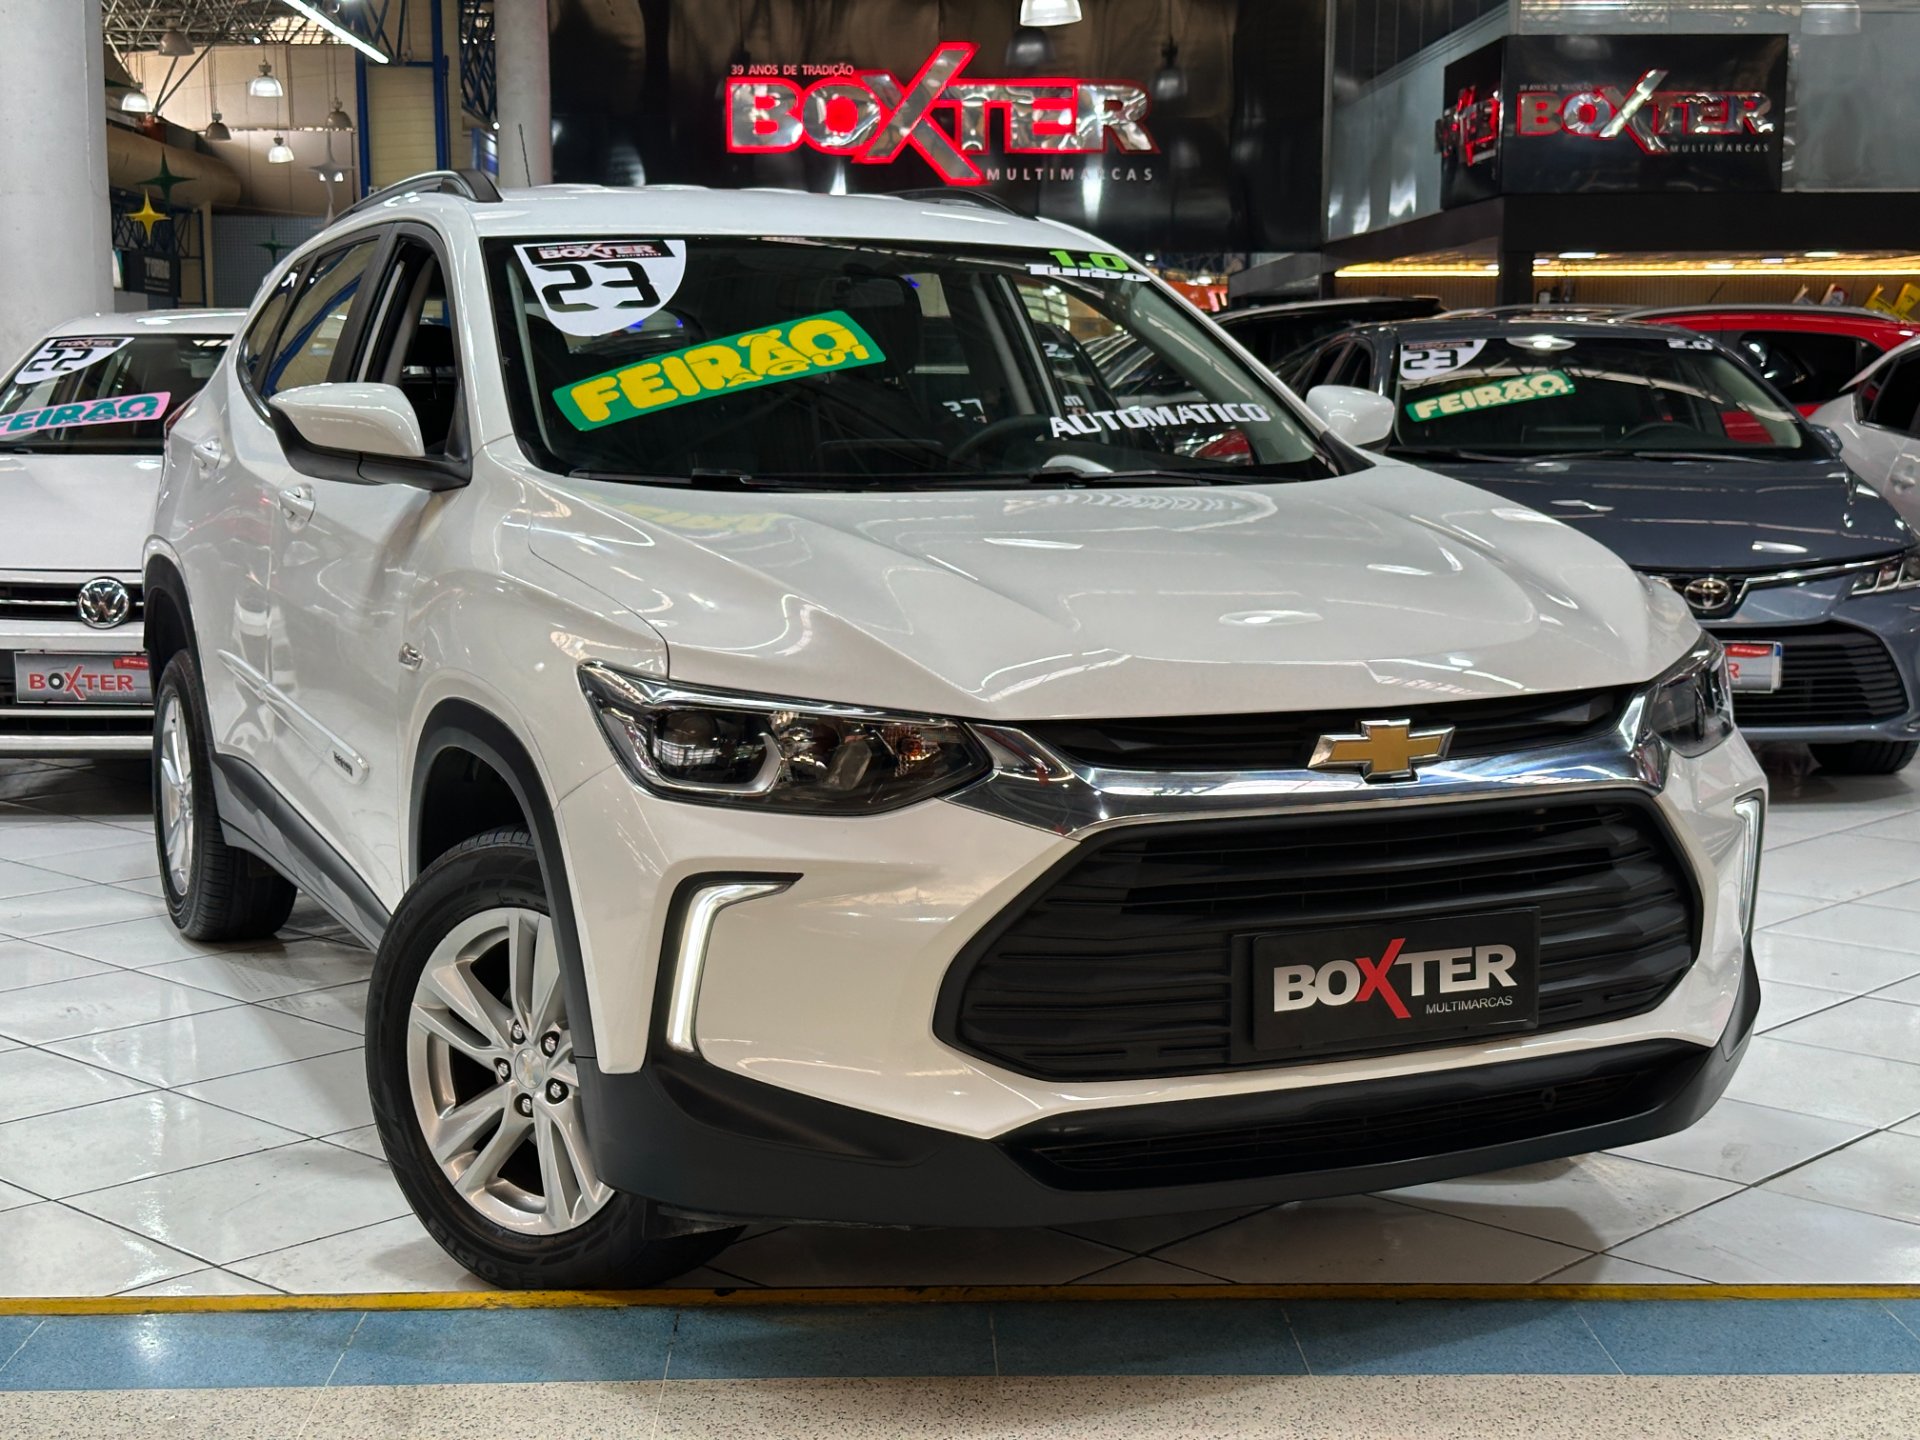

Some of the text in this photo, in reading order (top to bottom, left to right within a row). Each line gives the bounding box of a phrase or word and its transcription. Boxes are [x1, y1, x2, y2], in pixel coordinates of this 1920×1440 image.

[731, 62, 854, 77] 39 ANOS DE TRADIÇÃO
[726, 41, 1160, 186] BOXTER
[1517, 69, 1774, 155] BOXTER
[1671, 144, 1769, 153] MULTIMARCAS
[986, 168, 1154, 182] MULTIMARCAS
[538, 243, 657, 259] BOXTER
[1049, 251, 1129, 271] 1.0
[536, 260, 661, 313] 23
[1667, 338, 1713, 350] 2.0
[24, 348, 94, 372] 22
[570, 319, 862, 422] FEIRÃO
[1403, 349, 1459, 370] 23
[1414, 374, 1564, 418] FEIRÃO
[28, 665, 135, 700] BOXTER
[1273, 938, 1518, 1019] BOXTER
[1425, 996, 1513, 1015] MULTIMARCAS
